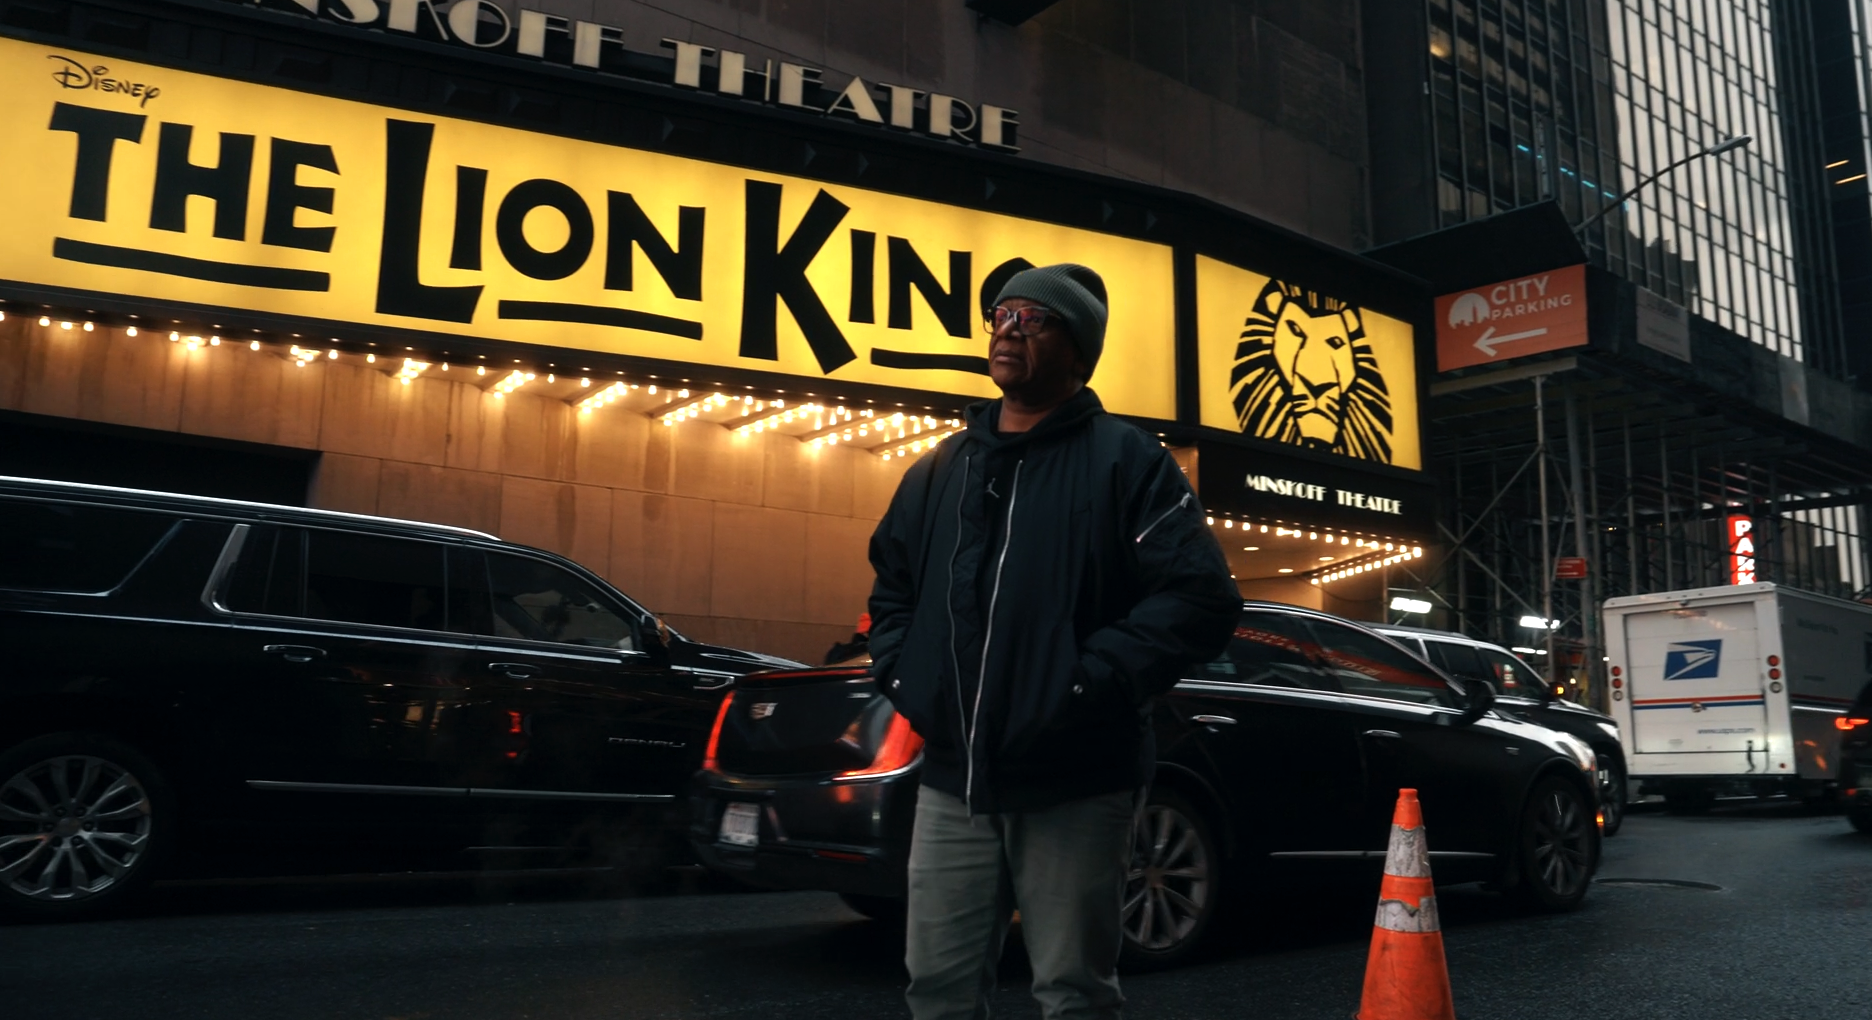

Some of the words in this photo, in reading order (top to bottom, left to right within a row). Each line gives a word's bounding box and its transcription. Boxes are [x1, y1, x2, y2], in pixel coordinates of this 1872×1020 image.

[660, 37, 1021, 154] THEATRE
[48, 101, 341, 253] THE
[1491, 275, 1549, 305] CITY
[1492, 294, 1572, 320] PARKING
[1245, 474, 1327, 501] MINSKOFF
[1336, 489, 1402, 515] THEATRE
